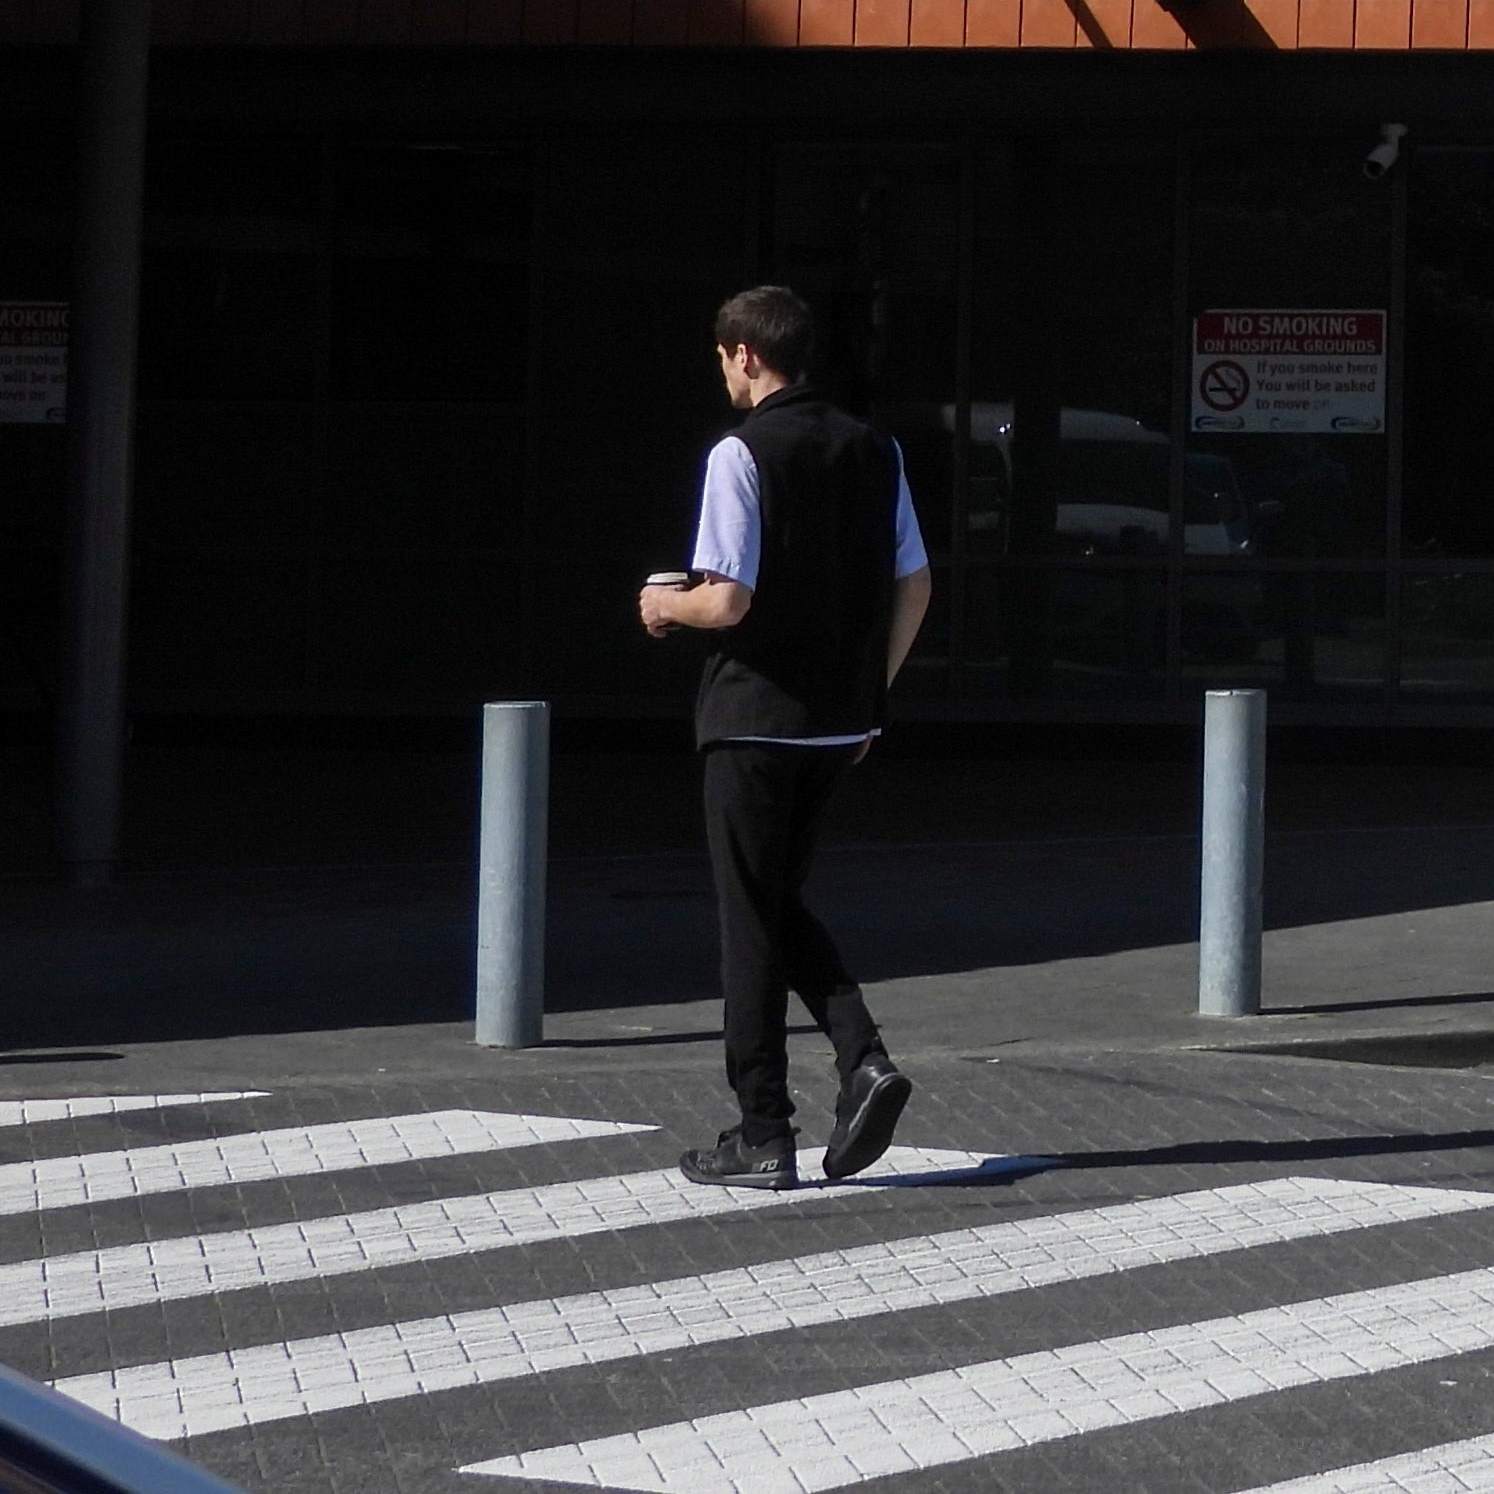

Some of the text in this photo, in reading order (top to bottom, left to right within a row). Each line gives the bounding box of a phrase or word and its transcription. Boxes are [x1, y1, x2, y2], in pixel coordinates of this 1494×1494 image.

[1223, 316, 1358, 336] NO SMOKING
[1204, 339, 1376, 354] ON HOSPITAL GROUNDS
[1257, 360, 1378, 377] If you smoke here
[1256, 378, 1376, 393] You will be asked
[1256, 398, 1271, 411] to
[1273, 399, 1311, 411] move
